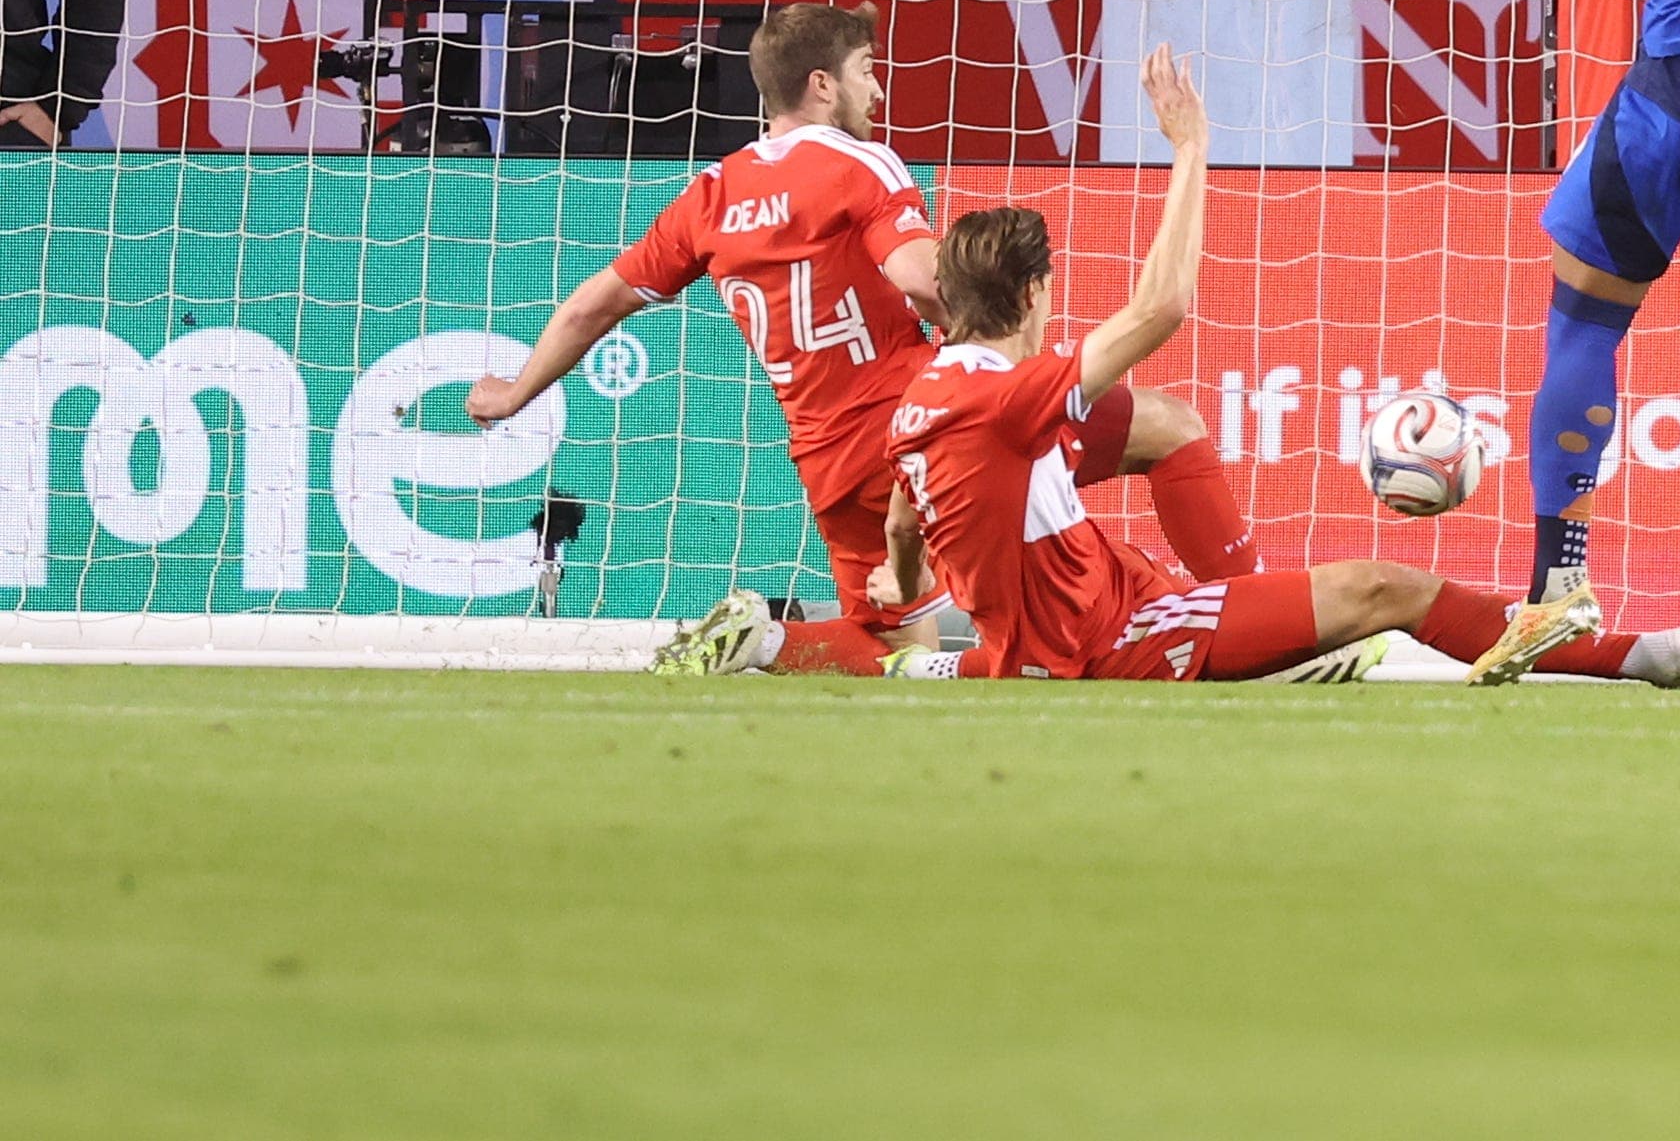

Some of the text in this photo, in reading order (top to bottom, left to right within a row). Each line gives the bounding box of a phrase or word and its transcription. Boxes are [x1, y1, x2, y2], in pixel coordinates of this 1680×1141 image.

[720, 191, 791, 234] DEAN
[720, 259, 877, 384] 24
[1220, 365, 1302, 463] If
